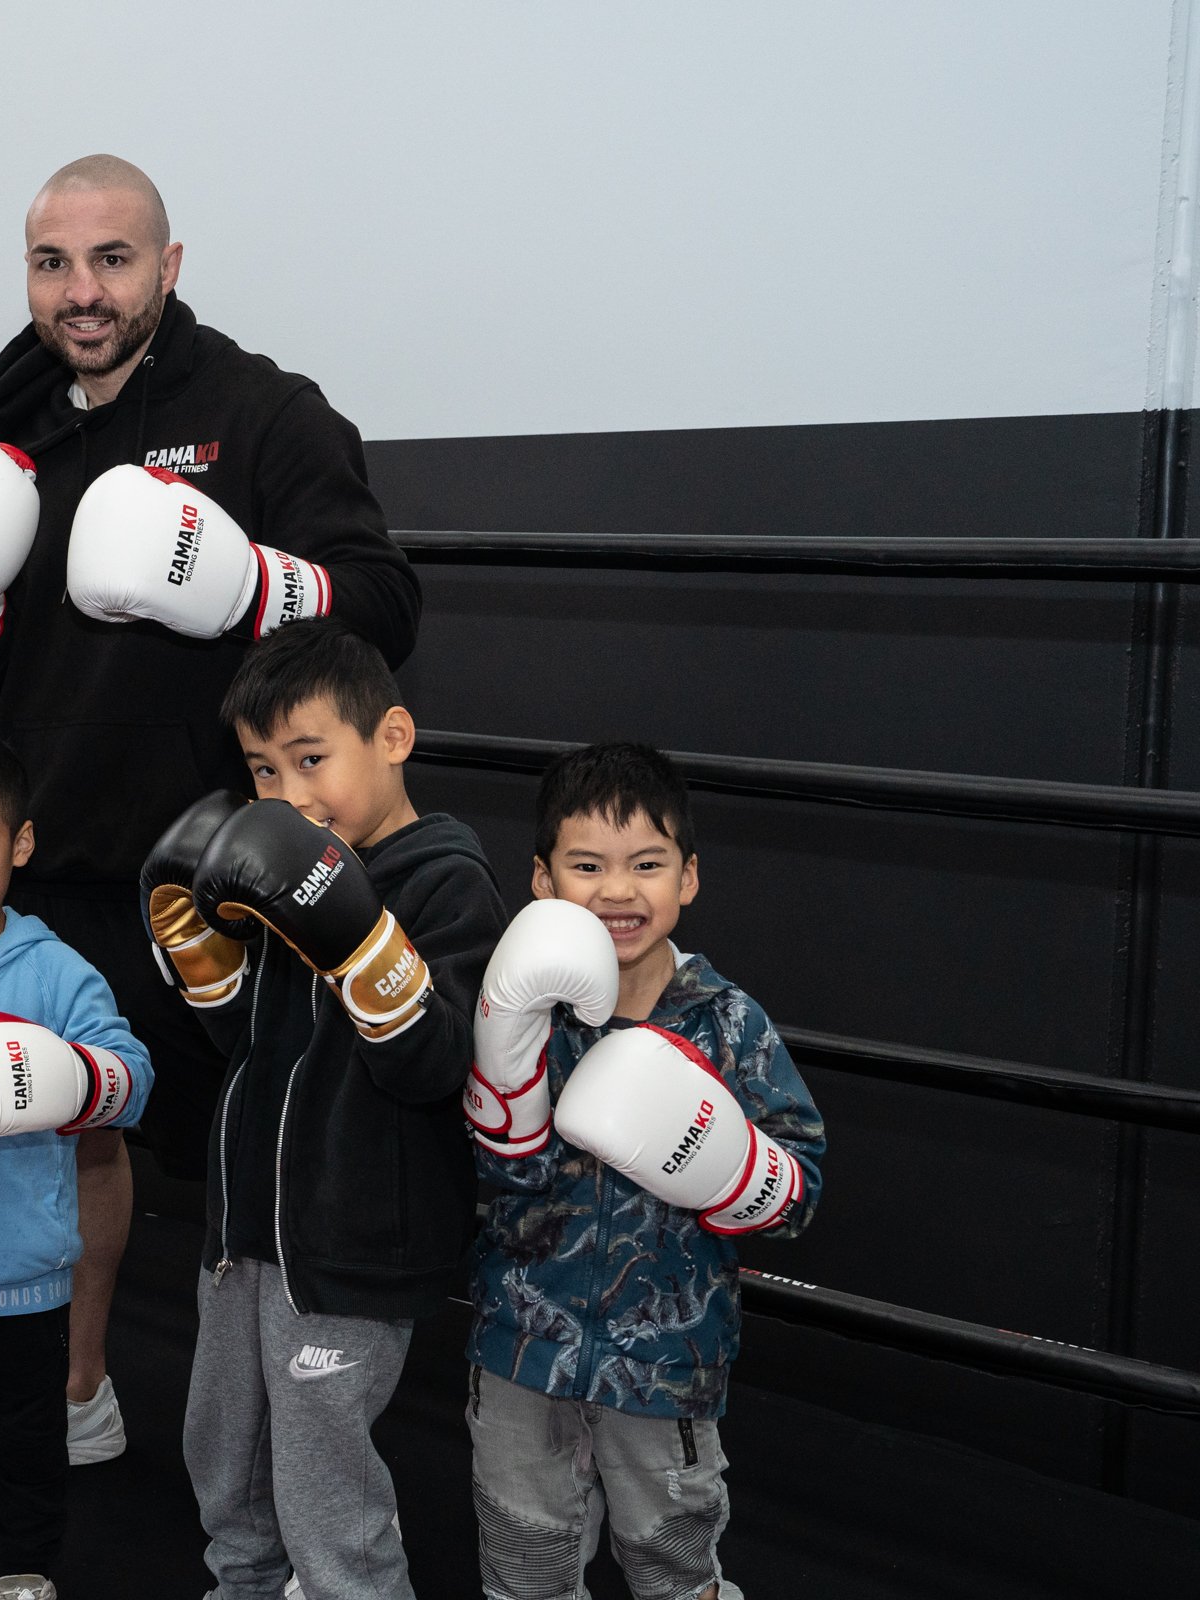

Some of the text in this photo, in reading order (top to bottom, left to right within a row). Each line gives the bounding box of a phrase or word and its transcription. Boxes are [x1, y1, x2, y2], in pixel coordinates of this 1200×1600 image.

[143, 440, 220, 468] CAMAKO
[181, 463, 209, 474] FITNESS
[167, 504, 198, 586] CAMAKO
[185, 554, 198, 582] BOXING
[194, 517, 205, 545] FITNESS
[275, 551, 298, 625] CAMAKO
[292, 844, 342, 906] CAMAKO
[308, 885, 328, 906] BOXING
[328, 860, 345, 882] FITNESS
[374, 941, 416, 997] CAMA
[390, 974, 412, 998] BOXING
[6, 1041, 28, 1110] CAMAKO
[22, 1047, 31, 1072] FITNESS
[661, 1099, 714, 1175] CAMAKO
[677, 1151, 697, 1174] BOXING
[700, 1116, 717, 1143] FITNESS
[732, 1147, 779, 1220] CAMAKO
[297, 1344, 343, 1368] NIKE
